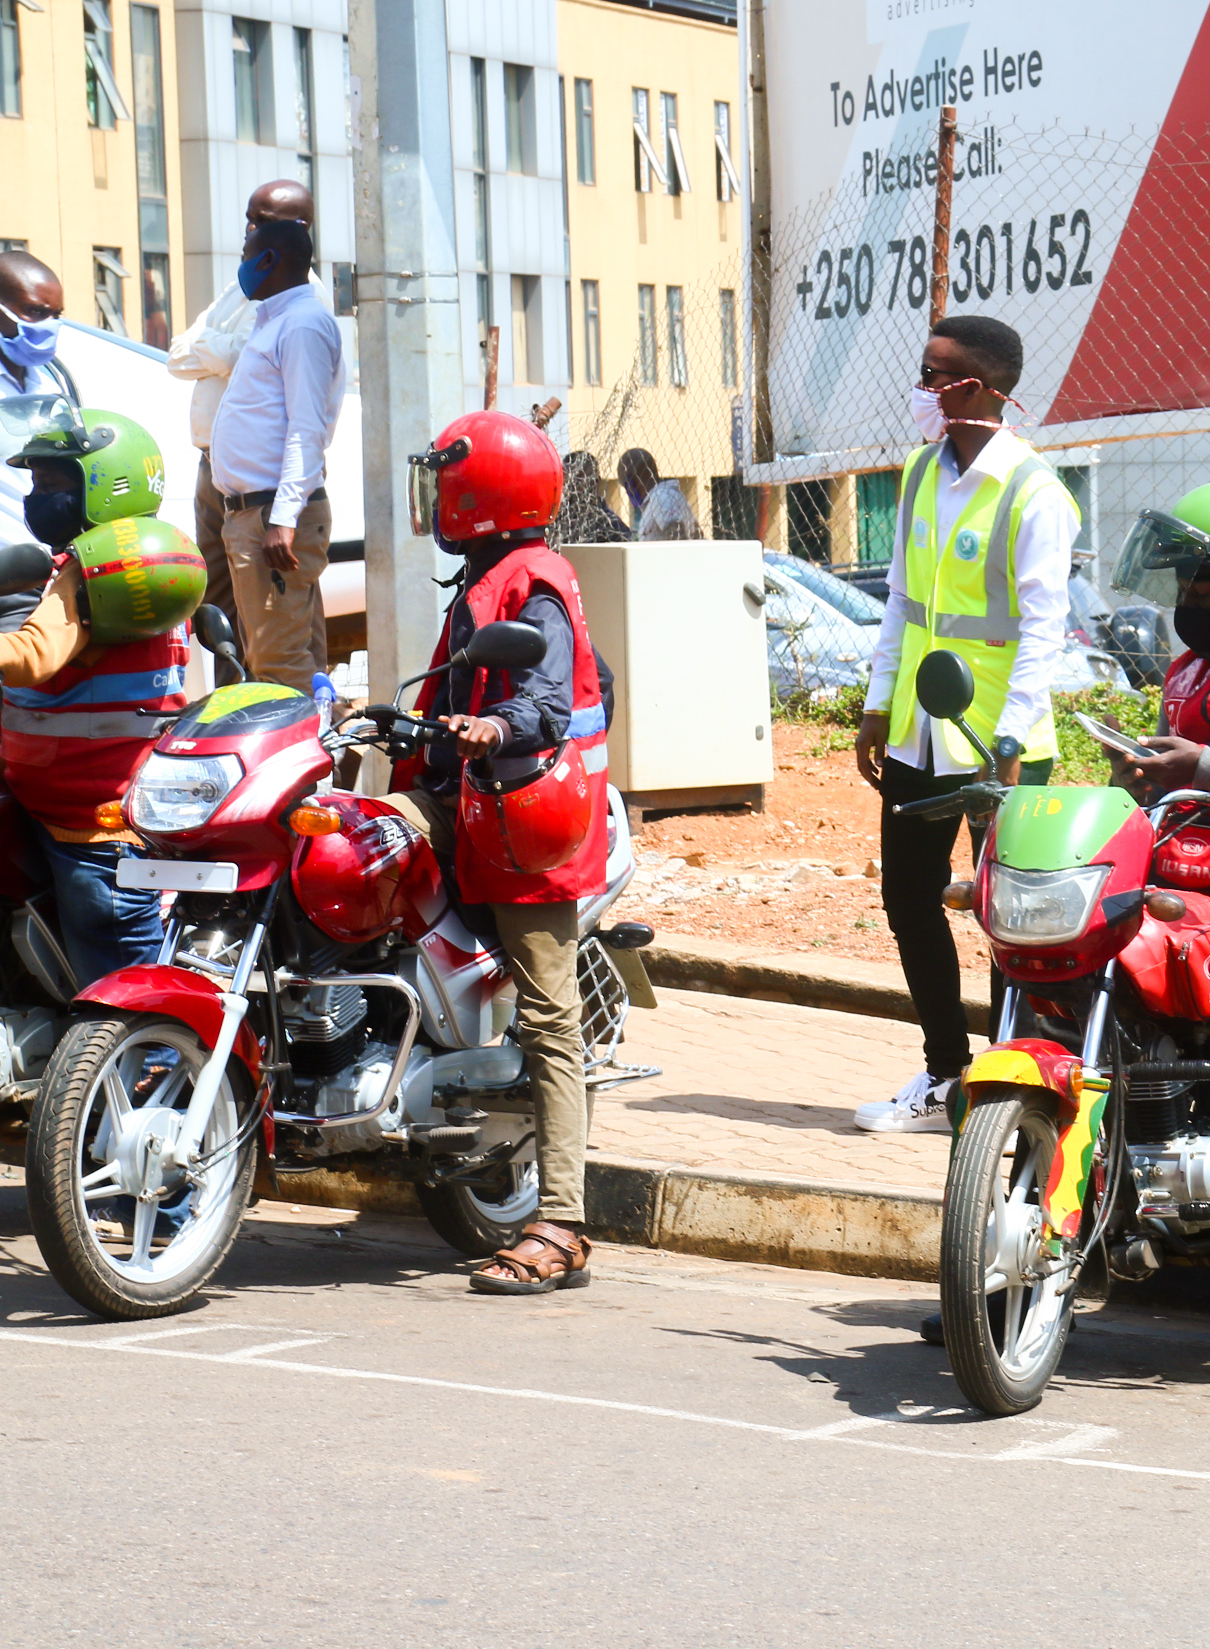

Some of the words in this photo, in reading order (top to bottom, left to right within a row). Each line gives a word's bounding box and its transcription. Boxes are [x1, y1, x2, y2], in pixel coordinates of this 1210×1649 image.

[830, 81, 855, 127] To
[863, 57, 974, 122] Advertise
[984, 47, 1043, 97] Here
[863, 148, 938, 197] Please
[797, 243, 874, 320] +250
